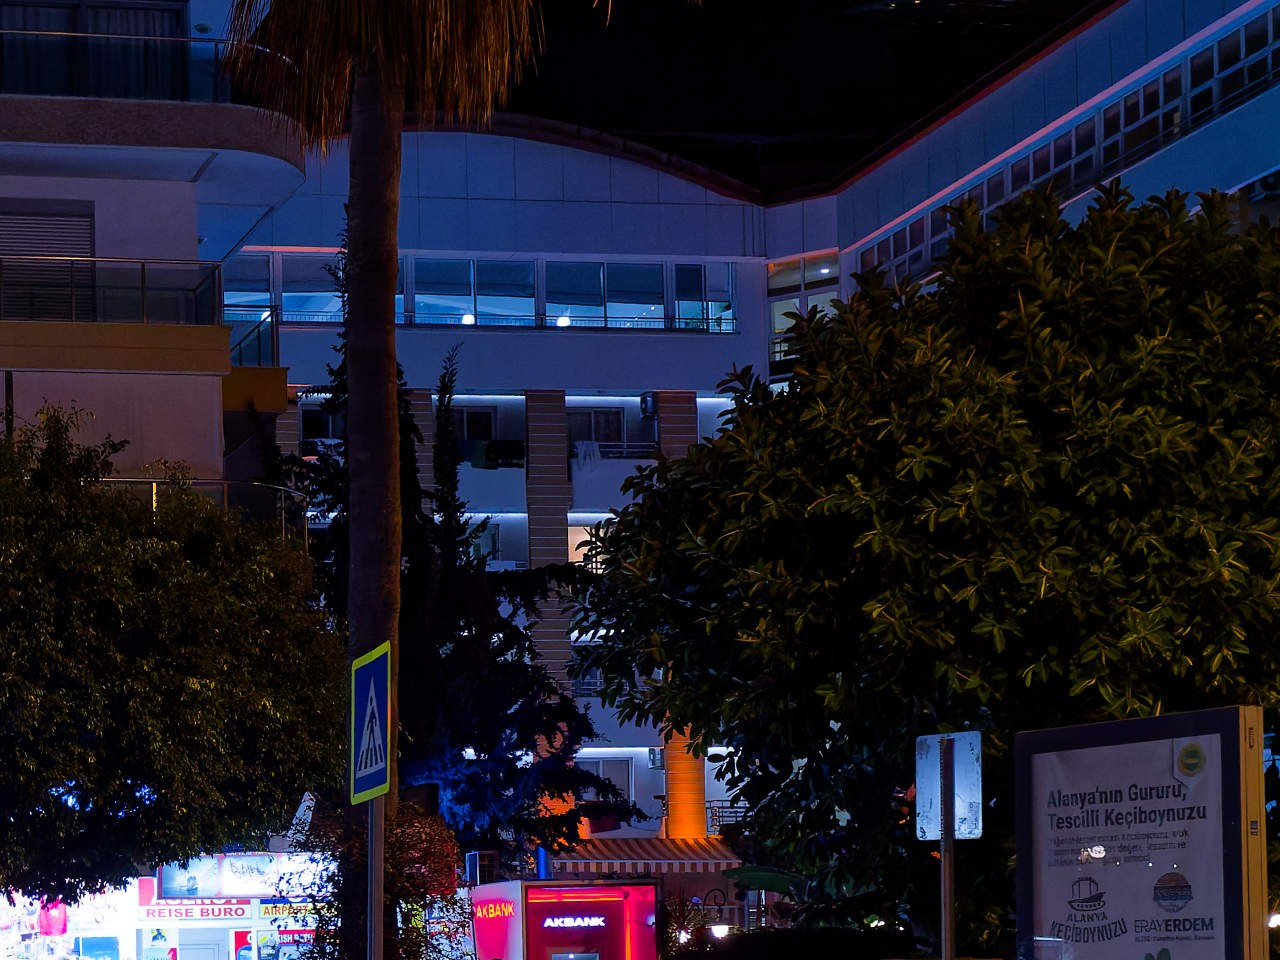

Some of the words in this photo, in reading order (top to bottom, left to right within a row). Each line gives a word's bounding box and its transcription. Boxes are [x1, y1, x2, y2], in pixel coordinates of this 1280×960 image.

[1047, 786, 1123, 810] Alanya'nın
[1128, 783, 1187, 802] Gururu,
[1047, 808, 1100, 830] Tescilli
[1104, 804, 1207, 830] Keçiboynuzu
[146, 907, 194, 918] REISE
[200, 906, 246, 917] BURO
[476, 901, 515, 918] AKBANK
[543, 916, 606, 928] AKBANK
[1067, 911, 1108, 923] ALANYA
